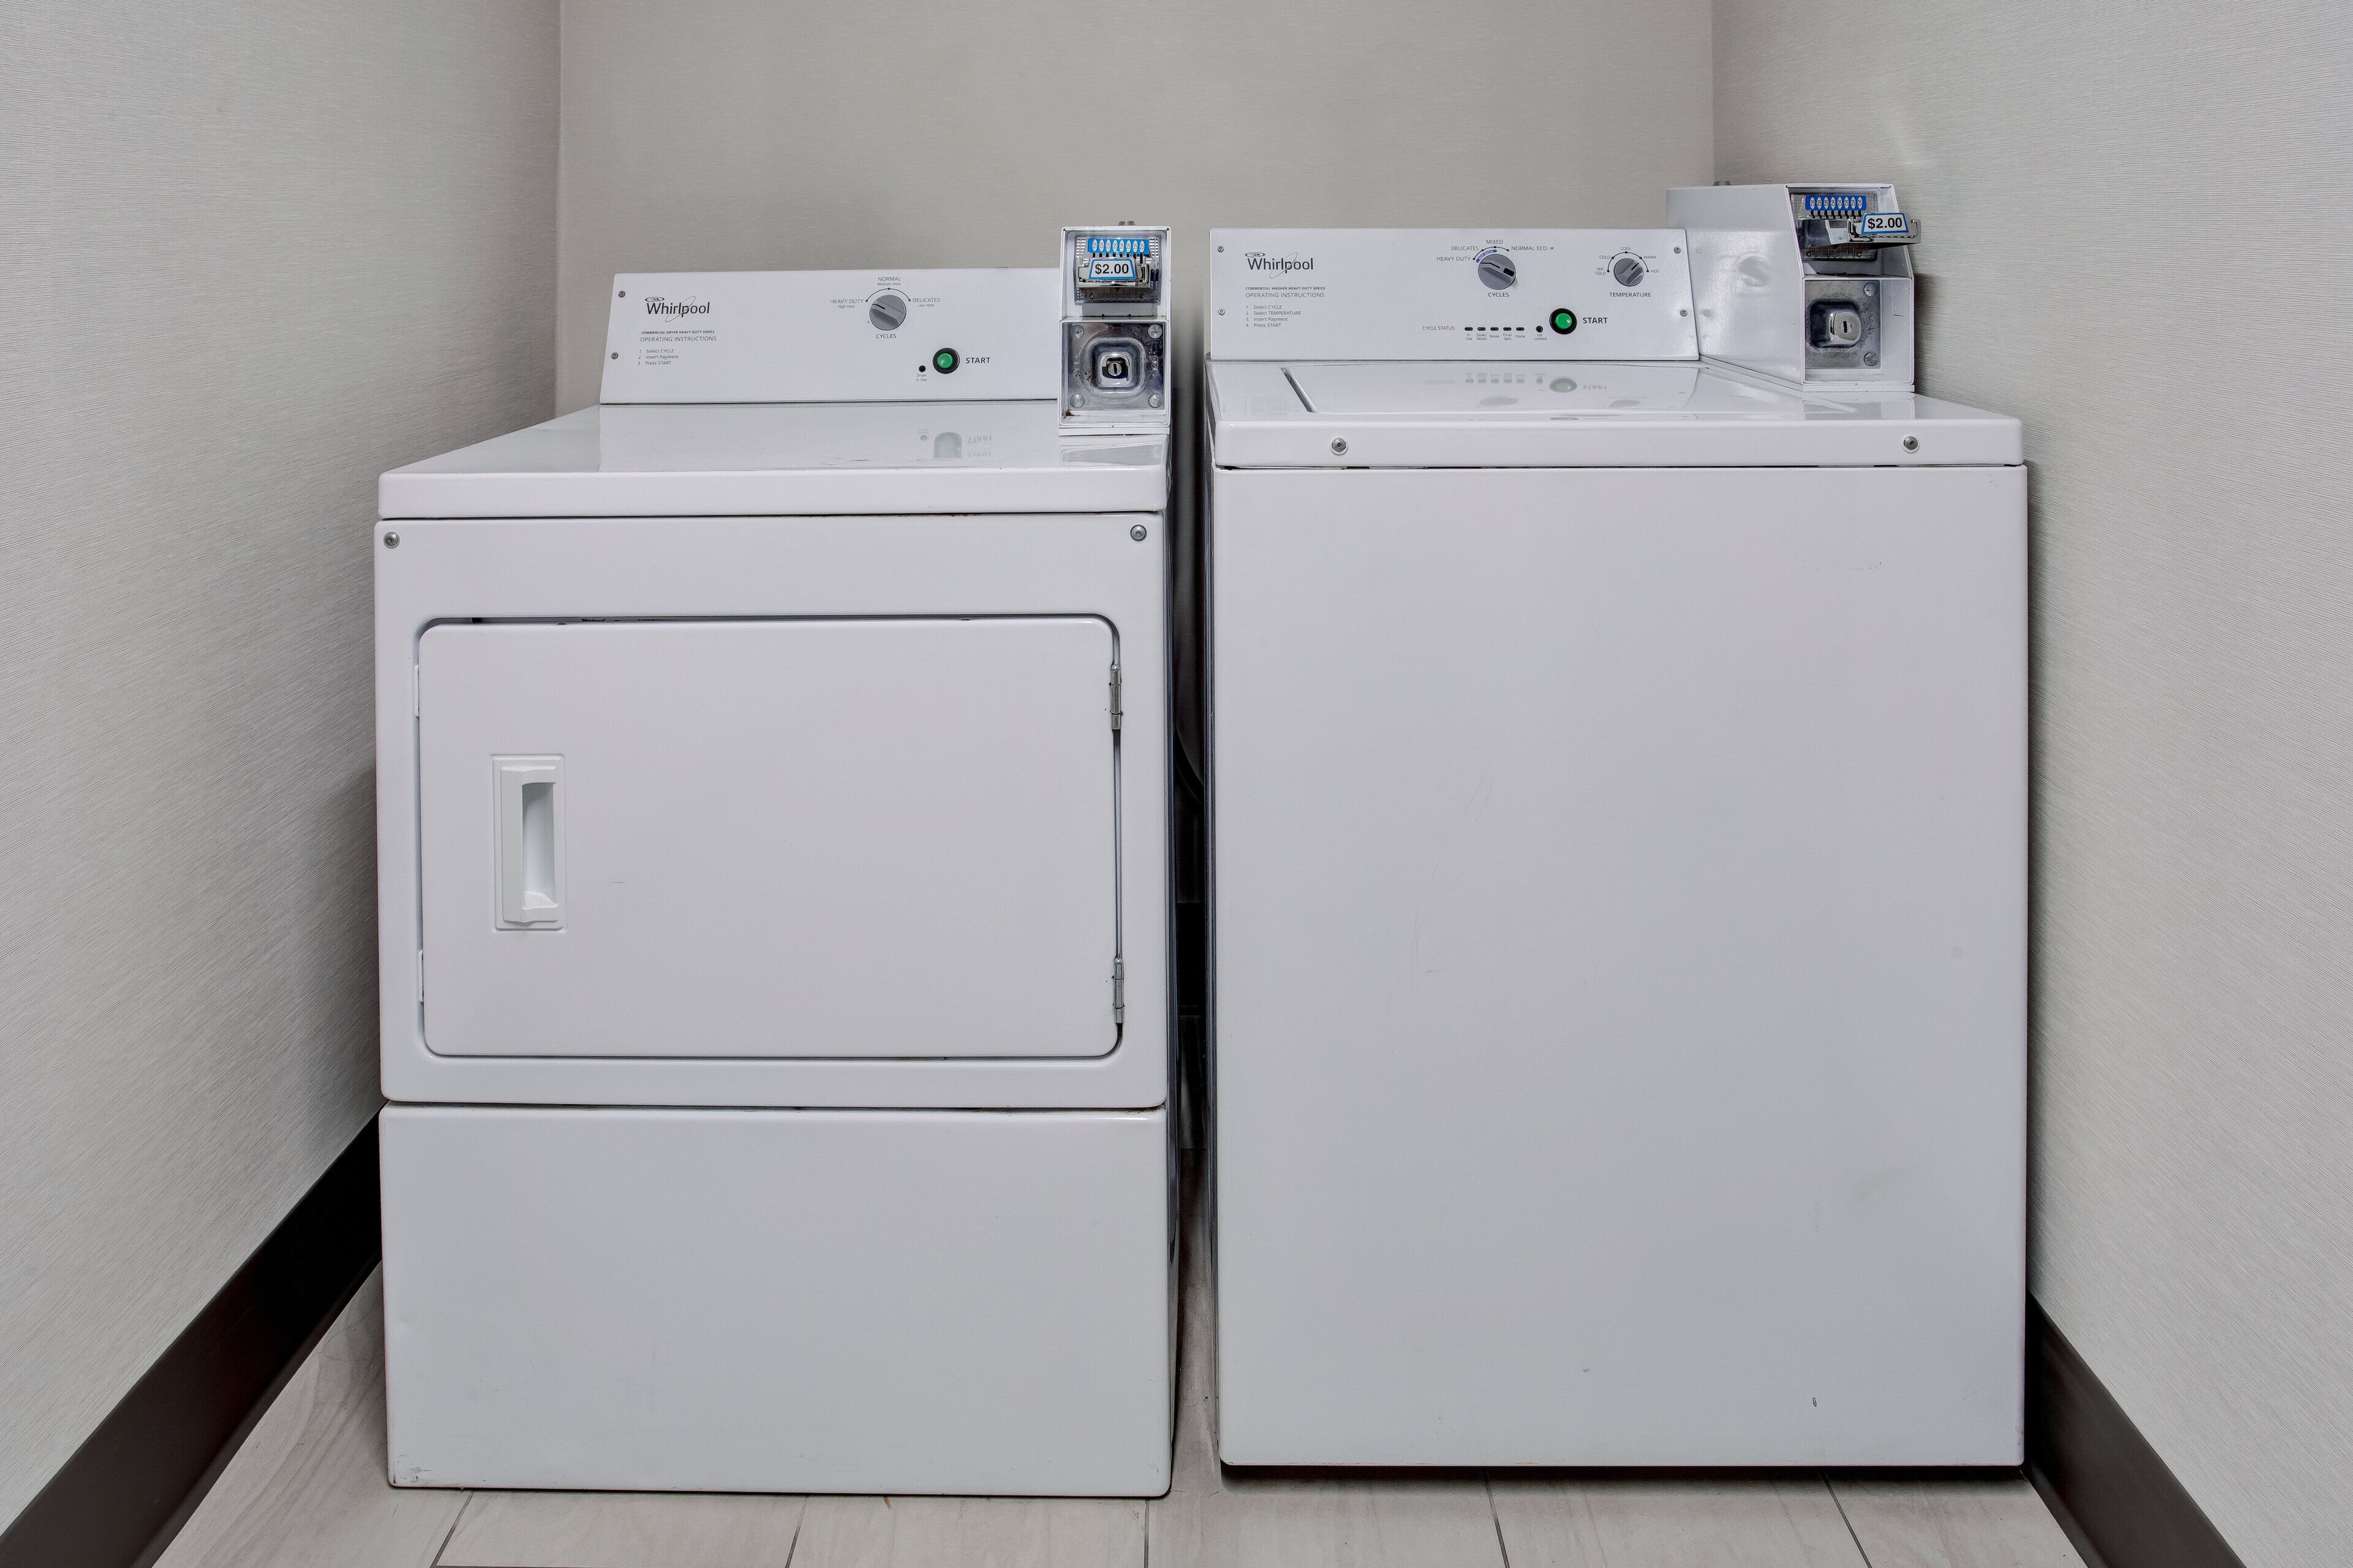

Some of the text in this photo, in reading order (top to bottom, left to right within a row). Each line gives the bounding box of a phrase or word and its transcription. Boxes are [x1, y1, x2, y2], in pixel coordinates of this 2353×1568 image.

[1868, 217, 1903, 230] $2.00
[1095, 263, 1129, 275] $2.00
[1247, 258, 1314, 274] Whirlpool
[646, 301, 710, 318] Whirlpool
